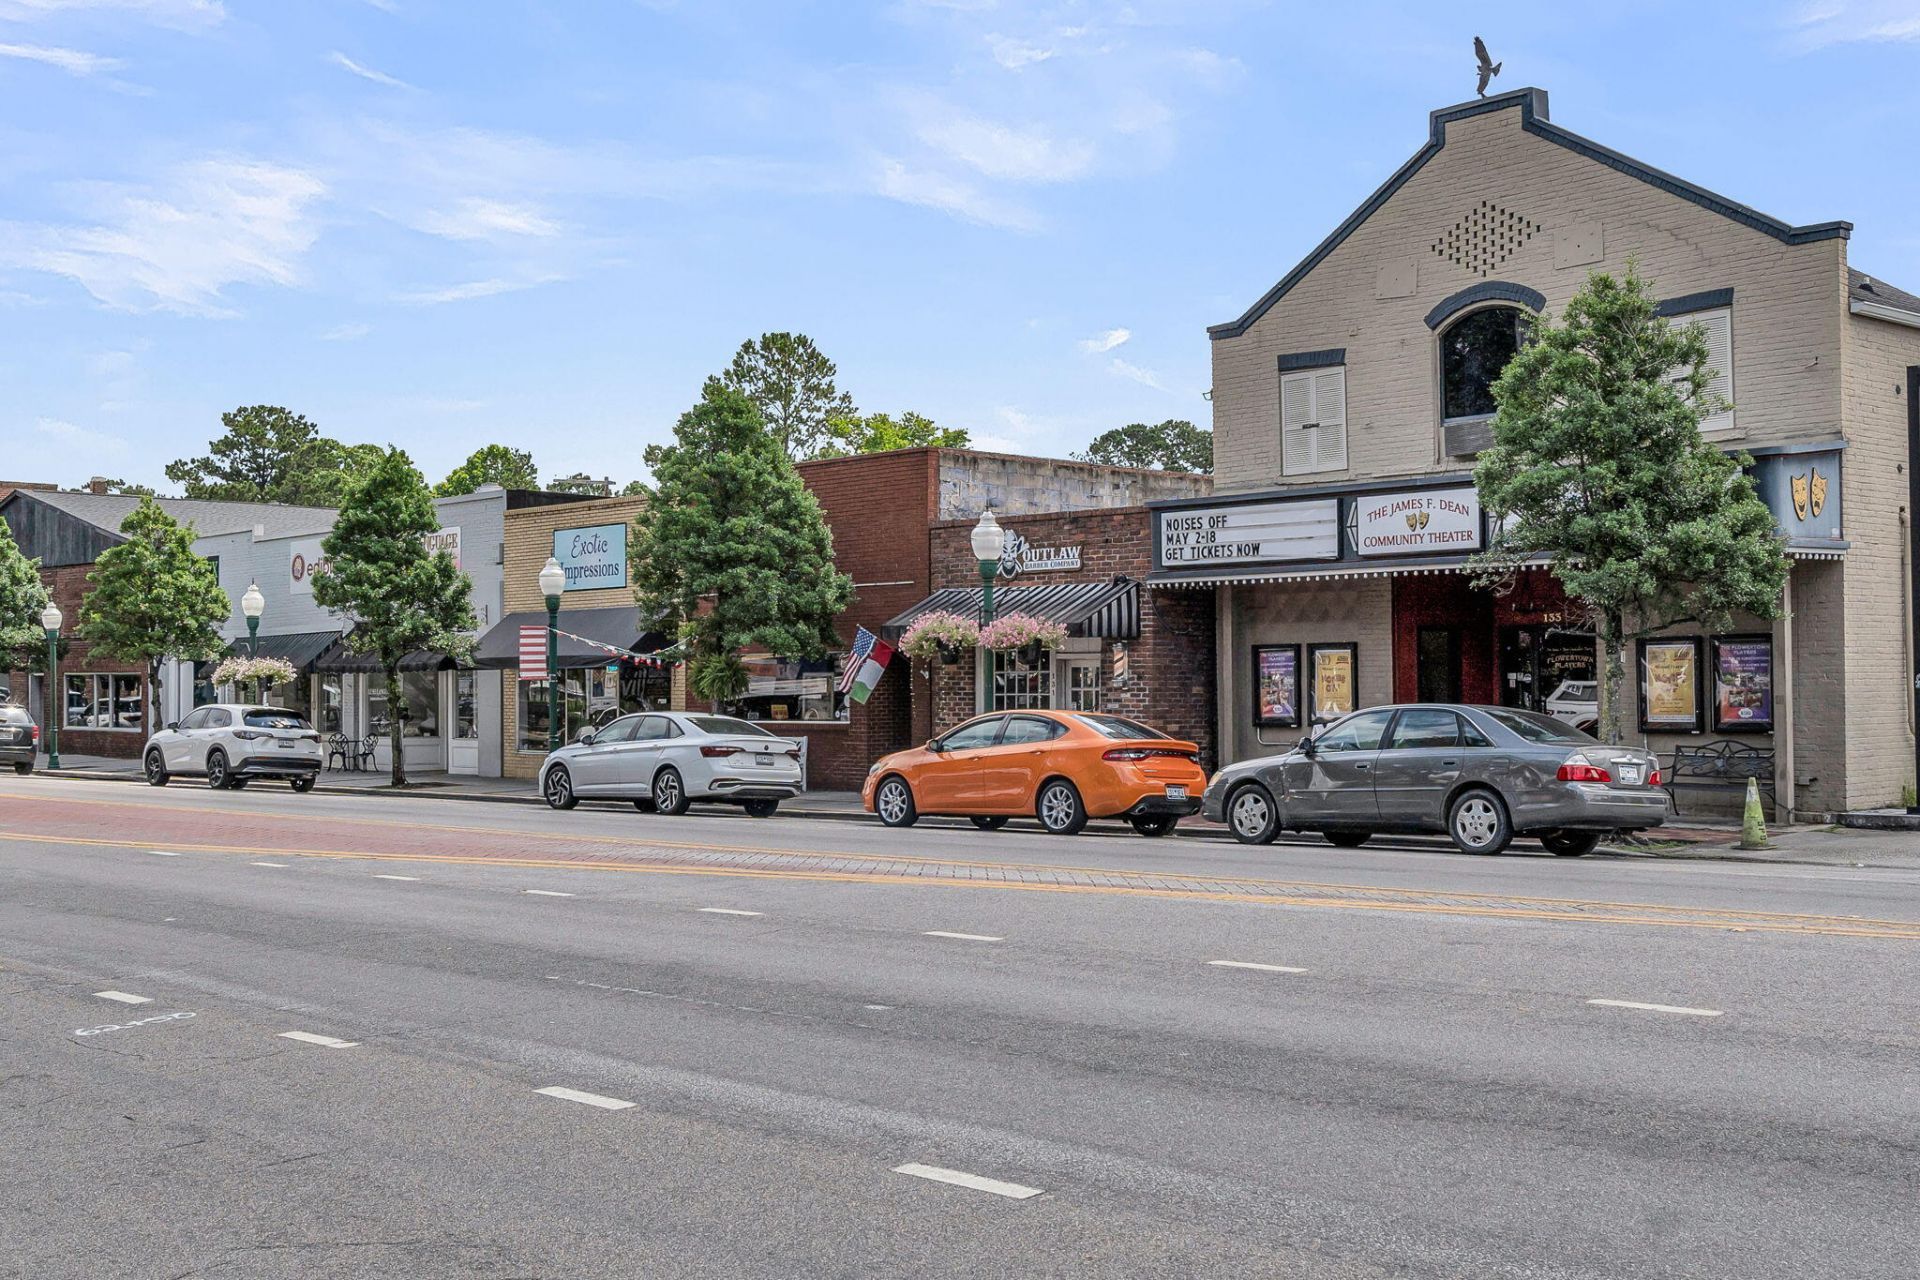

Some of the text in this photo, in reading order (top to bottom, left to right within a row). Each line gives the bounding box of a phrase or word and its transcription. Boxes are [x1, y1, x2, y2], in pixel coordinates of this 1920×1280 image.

[1367, 498, 1469, 523] THE JAMES F. DEAN
[1166, 515, 1228, 531] NOISES OFF
[571, 533, 608, 558] Exotic
[1166, 531, 1216, 545] MAY 2-18
[1363, 530, 1473, 548] COMMUNITY THEATER
[1022, 546, 1081, 561] OUTLAW
[1165, 543, 1261, 560] GET TICKETS NOW
[1050, 560, 1079, 568] COMPANY
